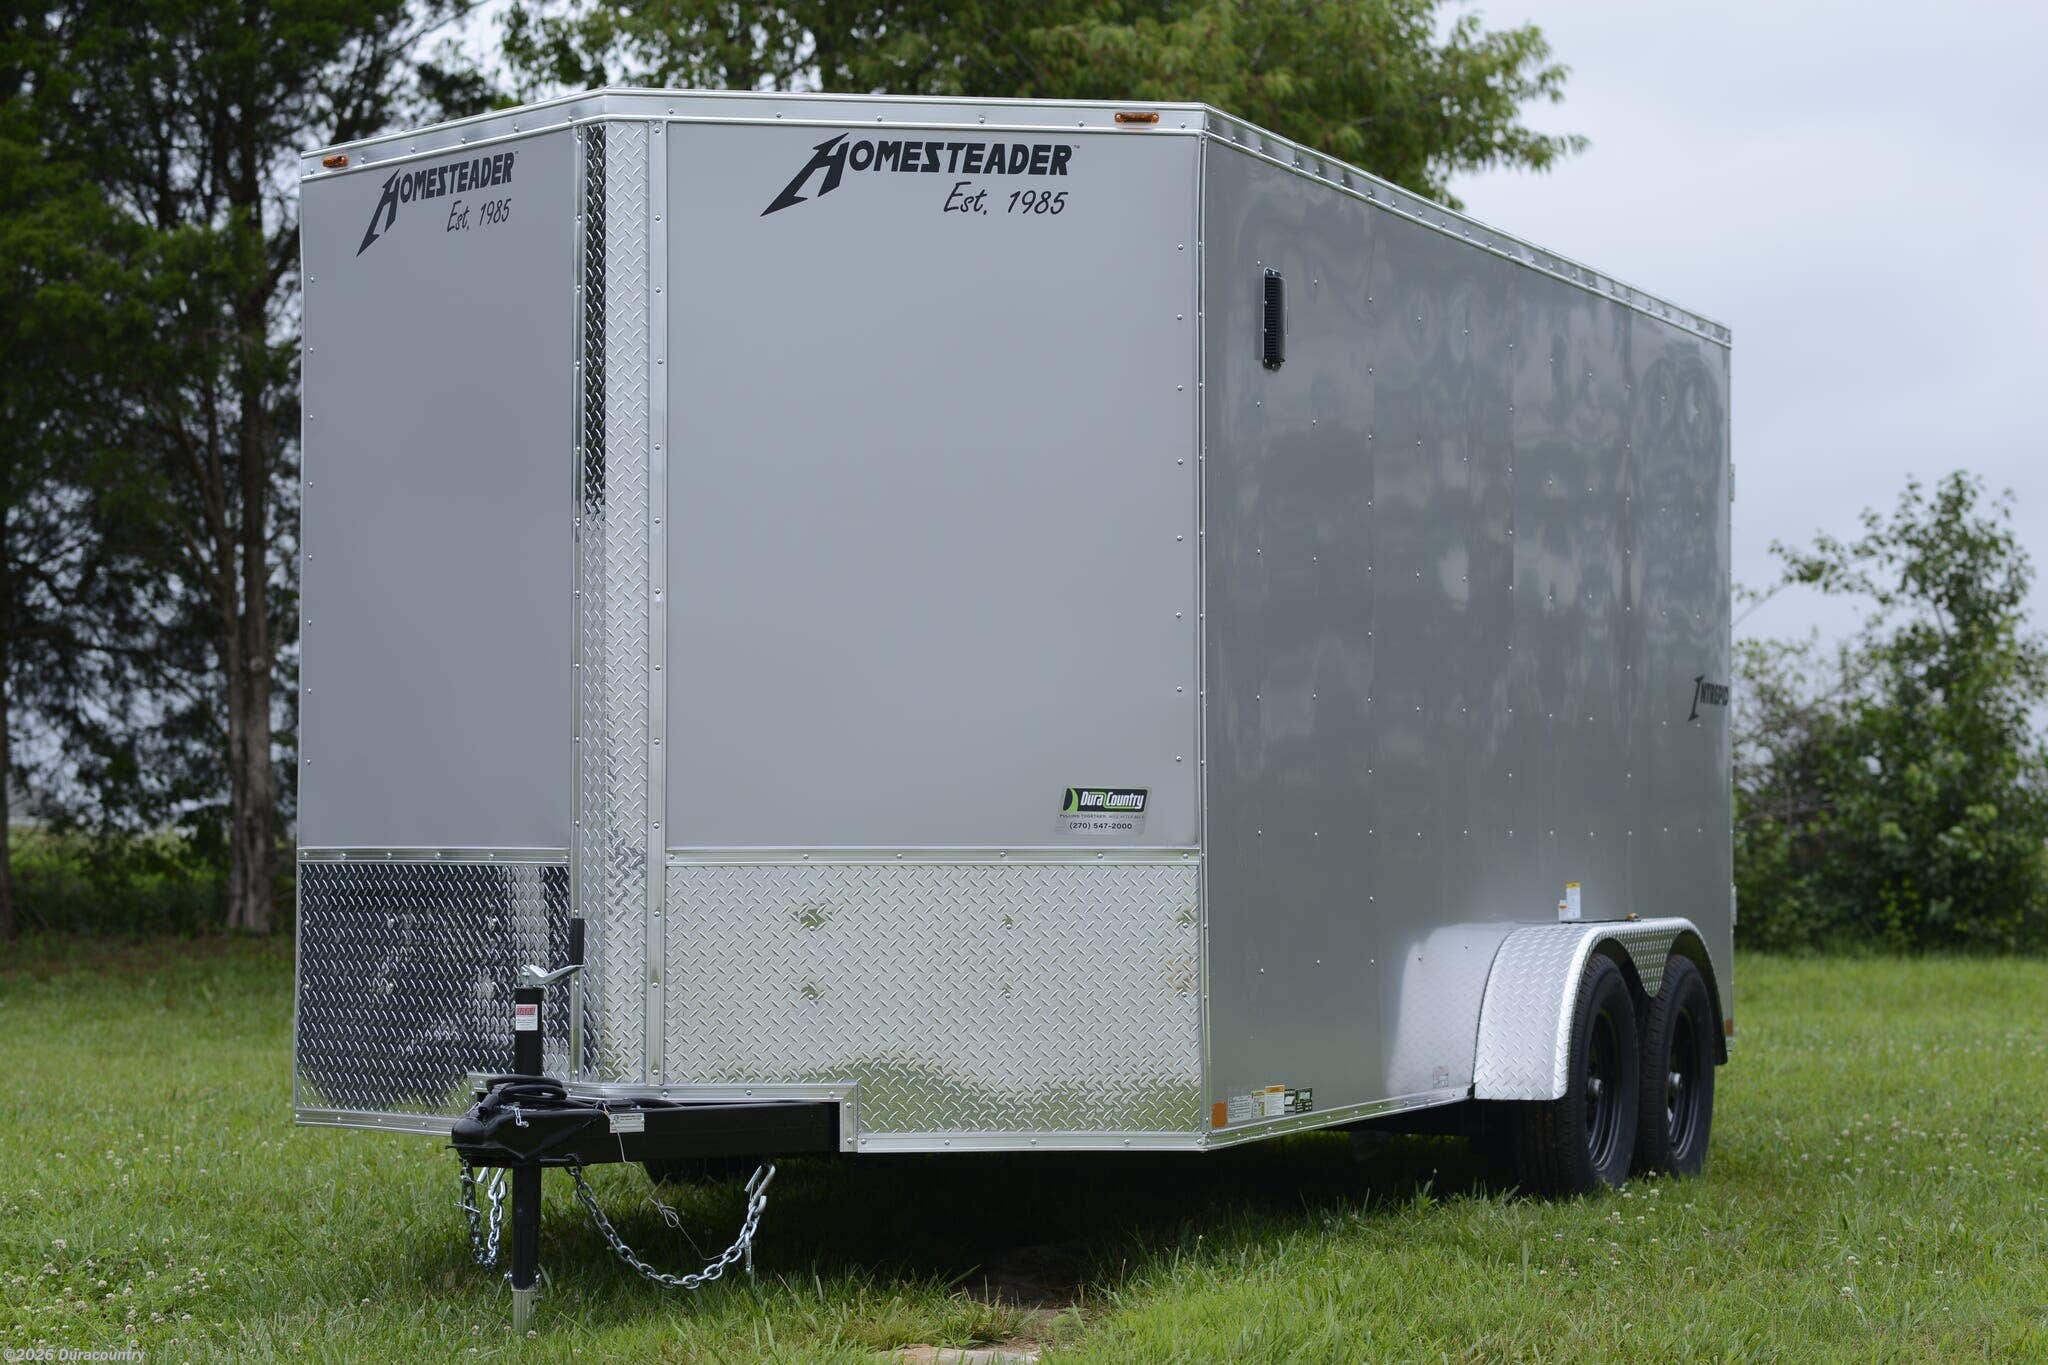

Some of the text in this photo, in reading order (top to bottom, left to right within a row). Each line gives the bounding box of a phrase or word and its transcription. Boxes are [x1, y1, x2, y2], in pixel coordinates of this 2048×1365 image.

[759, 132, 1073, 217] HOMESTEADER
[356, 152, 515, 258] HOMESTEADER
[447, 198, 512, 232] Est. 1985
[943, 181, 1069, 216] Est. 1985
[1069, 822, 1133, 830] (270) 547-2000
